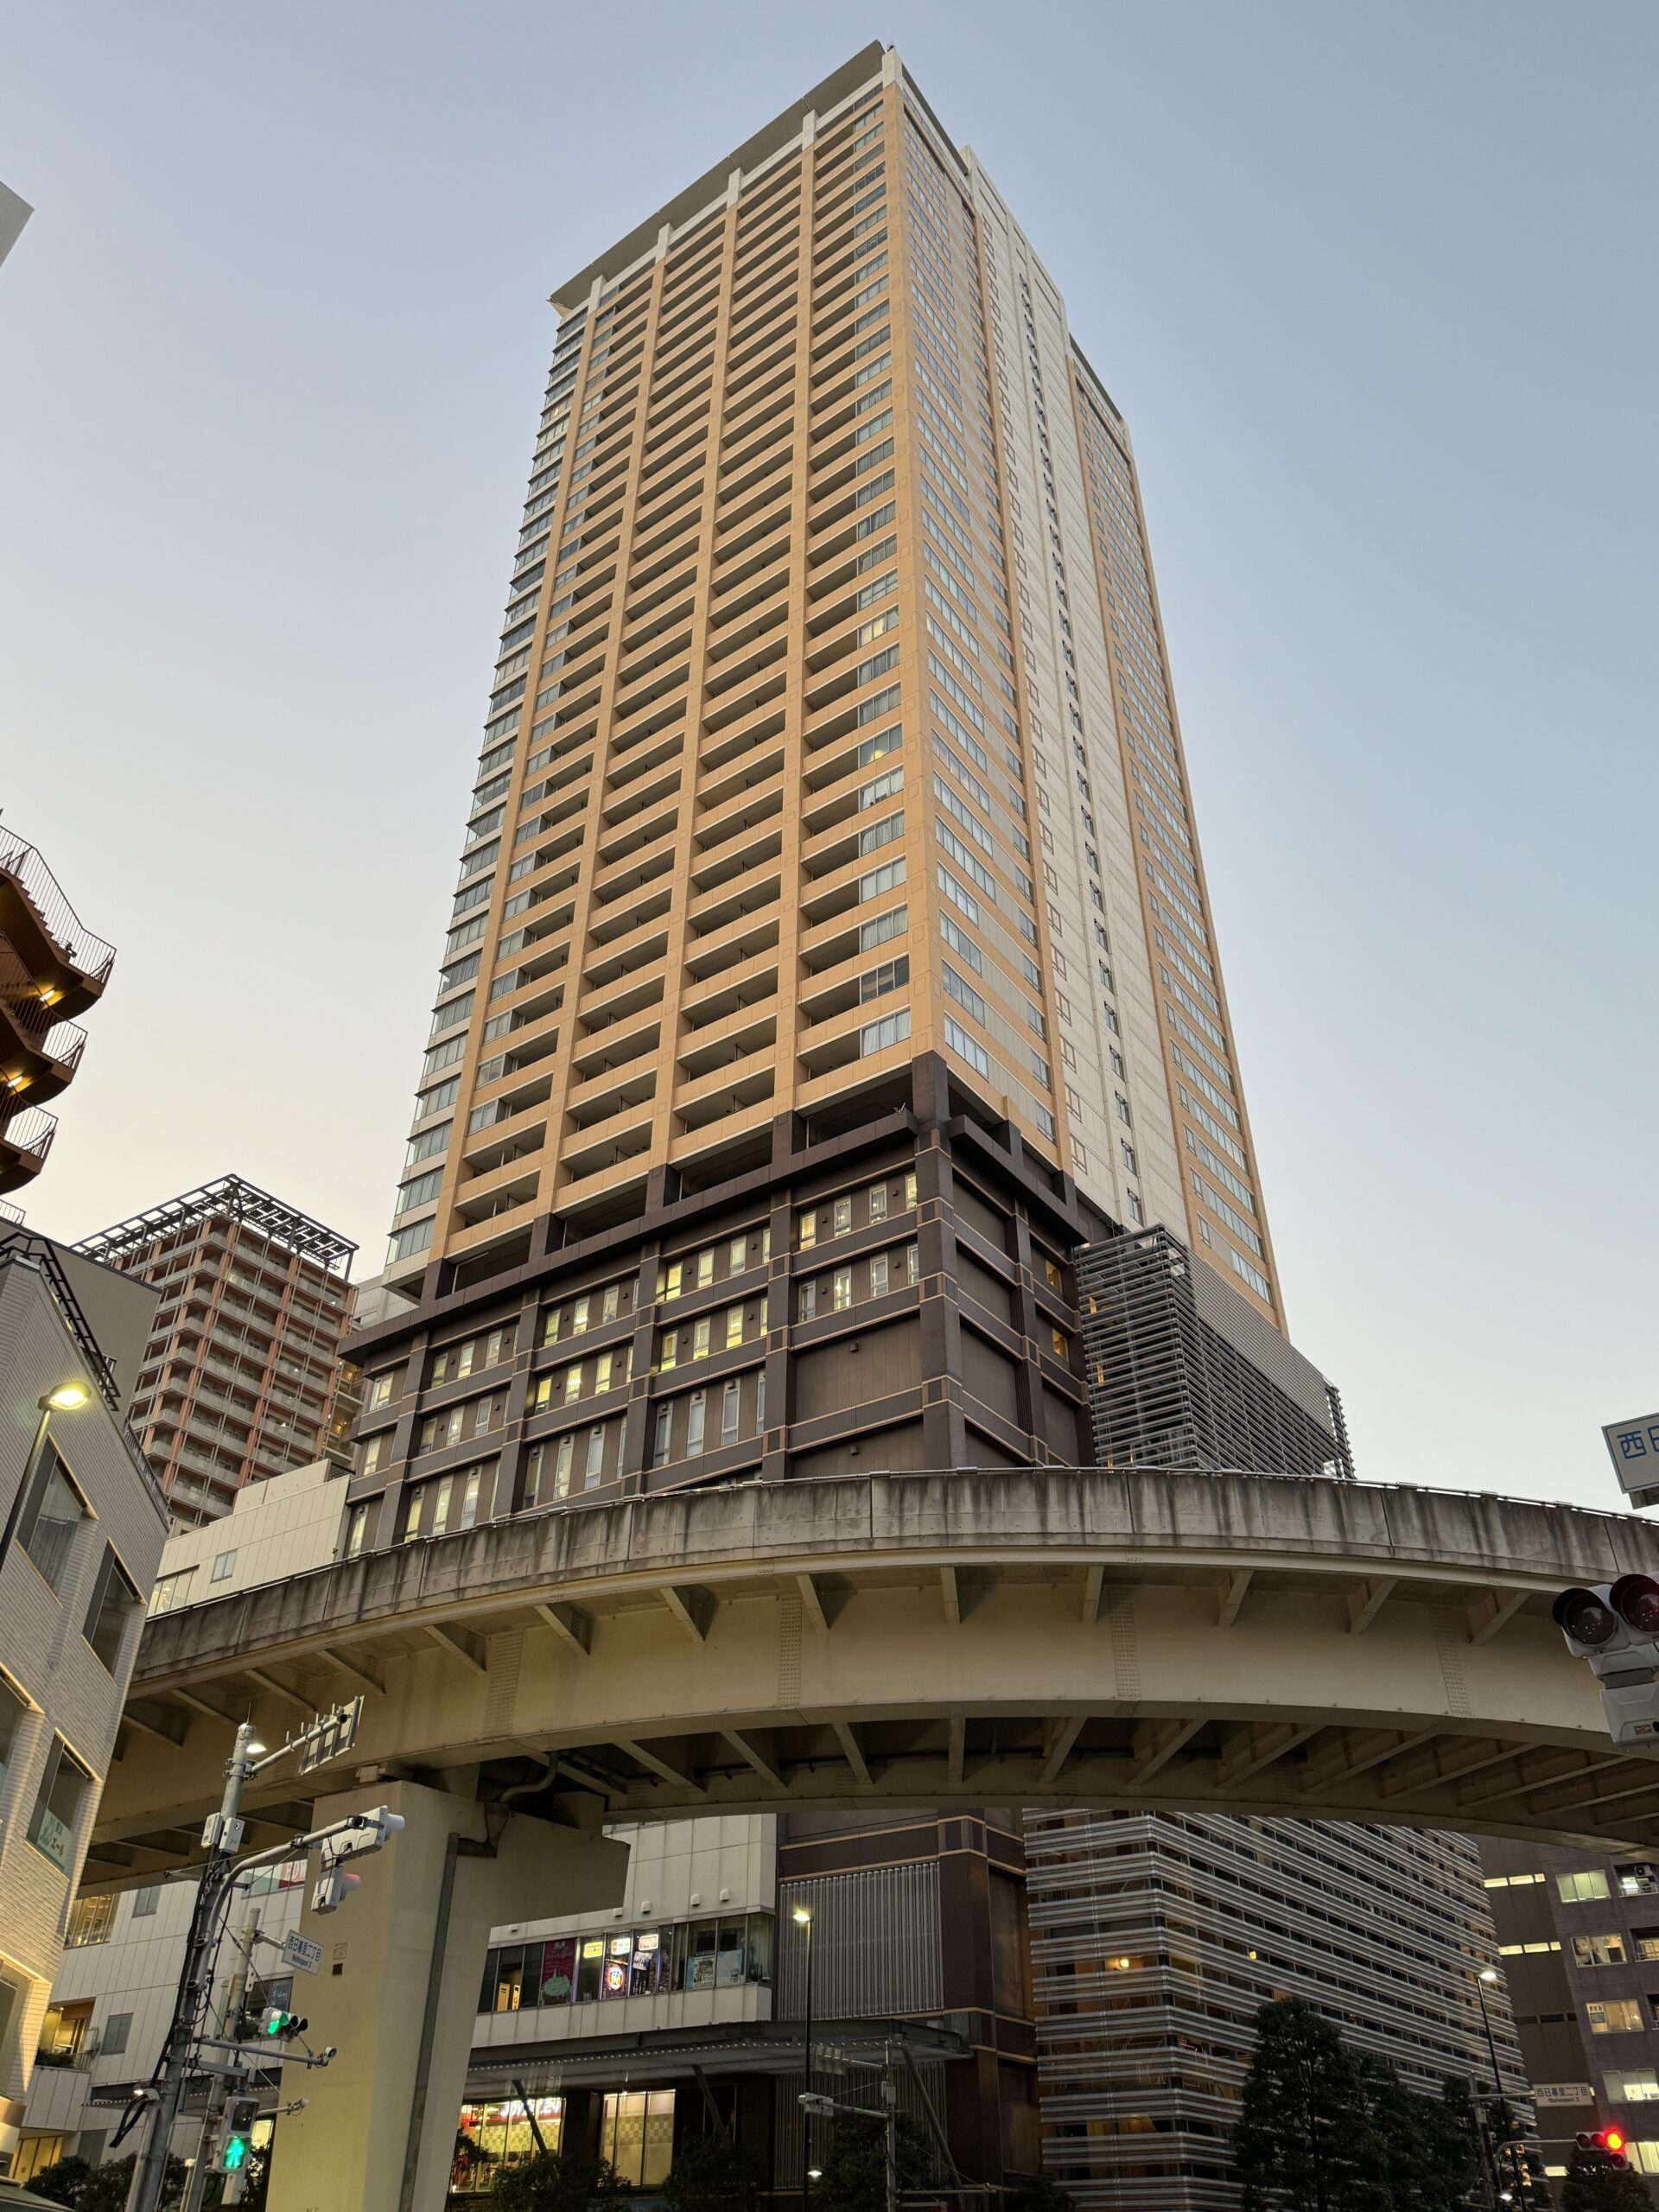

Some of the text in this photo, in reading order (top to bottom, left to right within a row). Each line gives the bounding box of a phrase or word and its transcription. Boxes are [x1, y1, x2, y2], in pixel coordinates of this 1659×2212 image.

[288, 1936, 321, 1961] 西日里二丁目
